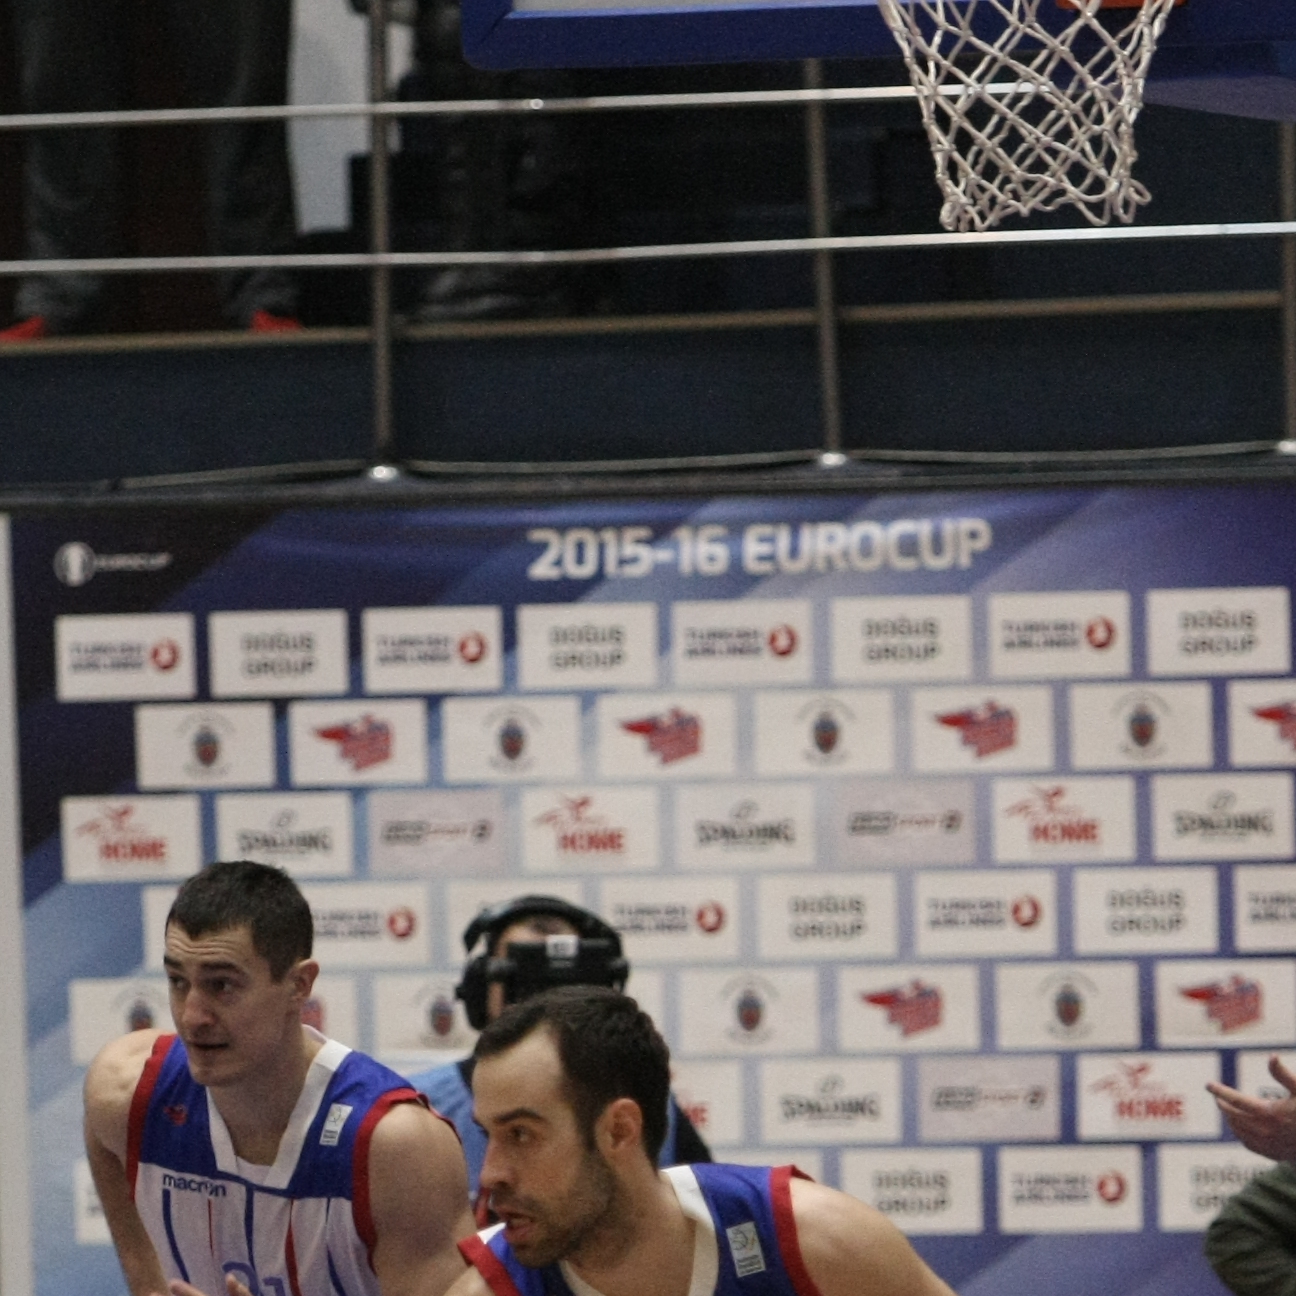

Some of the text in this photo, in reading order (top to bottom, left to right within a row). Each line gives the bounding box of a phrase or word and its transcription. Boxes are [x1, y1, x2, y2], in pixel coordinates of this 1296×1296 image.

[526, 518, 992, 580] 2015-16 EUROCUP
[162, 1172, 228, 1198] macron
